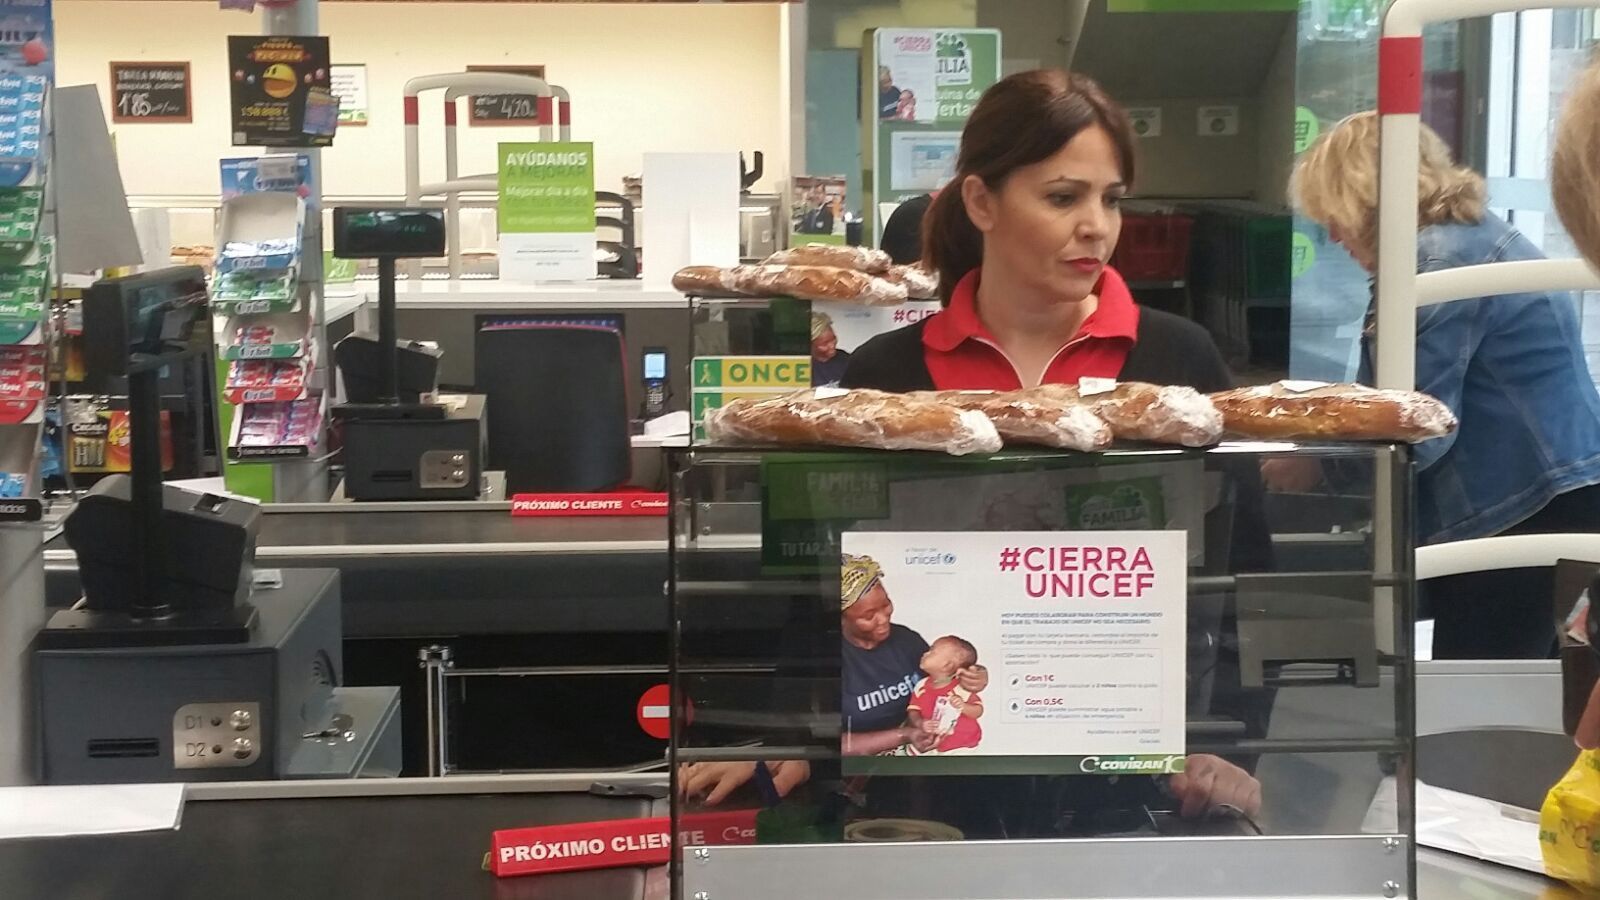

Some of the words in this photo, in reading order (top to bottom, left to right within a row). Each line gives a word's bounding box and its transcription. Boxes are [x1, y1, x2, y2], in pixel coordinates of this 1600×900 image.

[506, 150, 588, 166] AYÚDANOS
[729, 363, 812, 383] ONCE
[514, 499, 569, 510] PRÓXIMO
[571, 500, 622, 510] CLIENTE
[905, 553, 941, 566] unicef
[999, 547, 1154, 572] #CIERRA
[1026, 573, 1154, 598] UNICEF
[1025, 674, 1042, 682] Con
[857, 675, 914, 711] unicef
[1025, 698, 1042, 706] Con
[184, 715, 203, 730] D1
[186, 742, 207, 757] D2
[501, 838, 604, 863] PRÓXIMO
